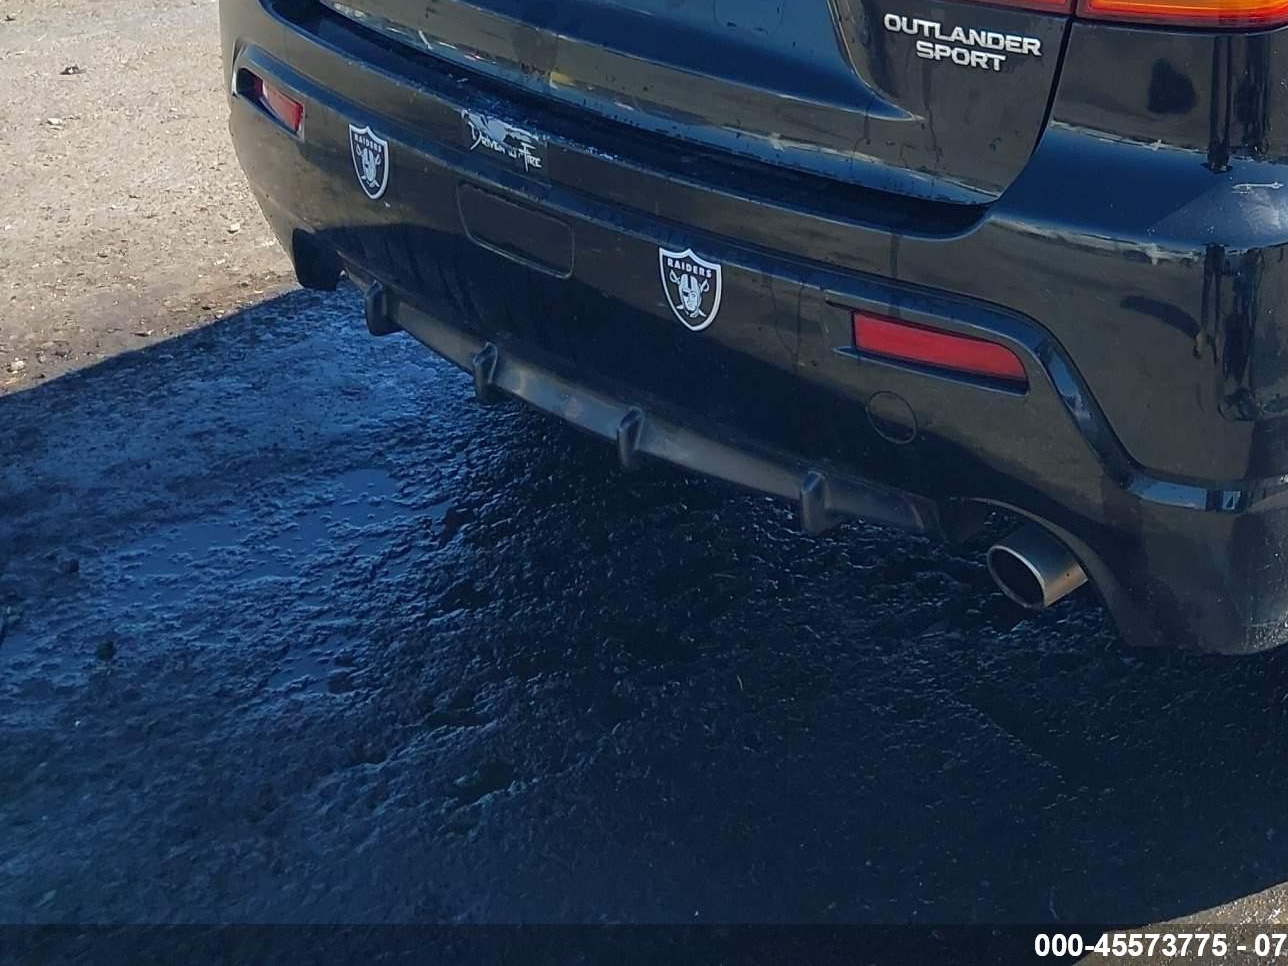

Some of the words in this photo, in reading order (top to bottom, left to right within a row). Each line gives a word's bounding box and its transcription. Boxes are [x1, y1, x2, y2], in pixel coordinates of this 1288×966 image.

[884, 13, 1042, 56] OUTLANDER
[916, 40, 1006, 71] SPORT
[354, 133, 382, 153] RAIDERS
[667, 258, 712, 278] RAIDERS
